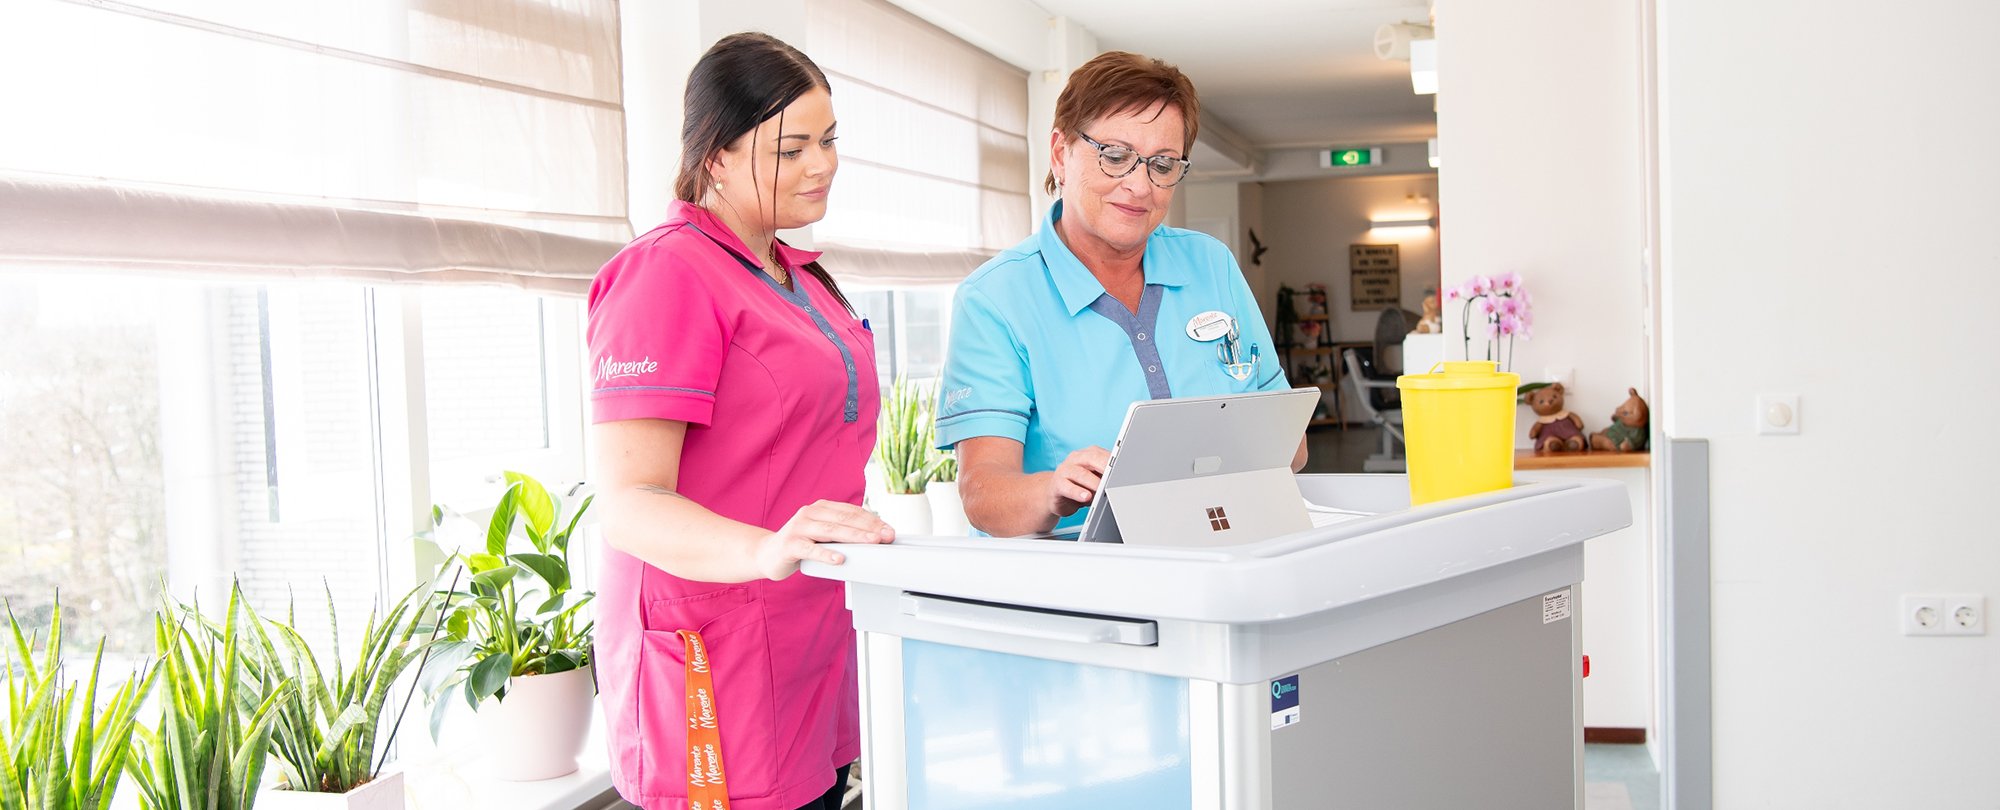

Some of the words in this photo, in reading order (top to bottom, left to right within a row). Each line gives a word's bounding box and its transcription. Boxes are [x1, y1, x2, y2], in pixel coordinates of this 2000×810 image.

[594, 355, 658, 382] Marente
[689, 634, 709, 673] Marente
[696, 688, 717, 729] Marente
[690, 745, 706, 788] Marente
[703, 743, 724, 785] Marente
